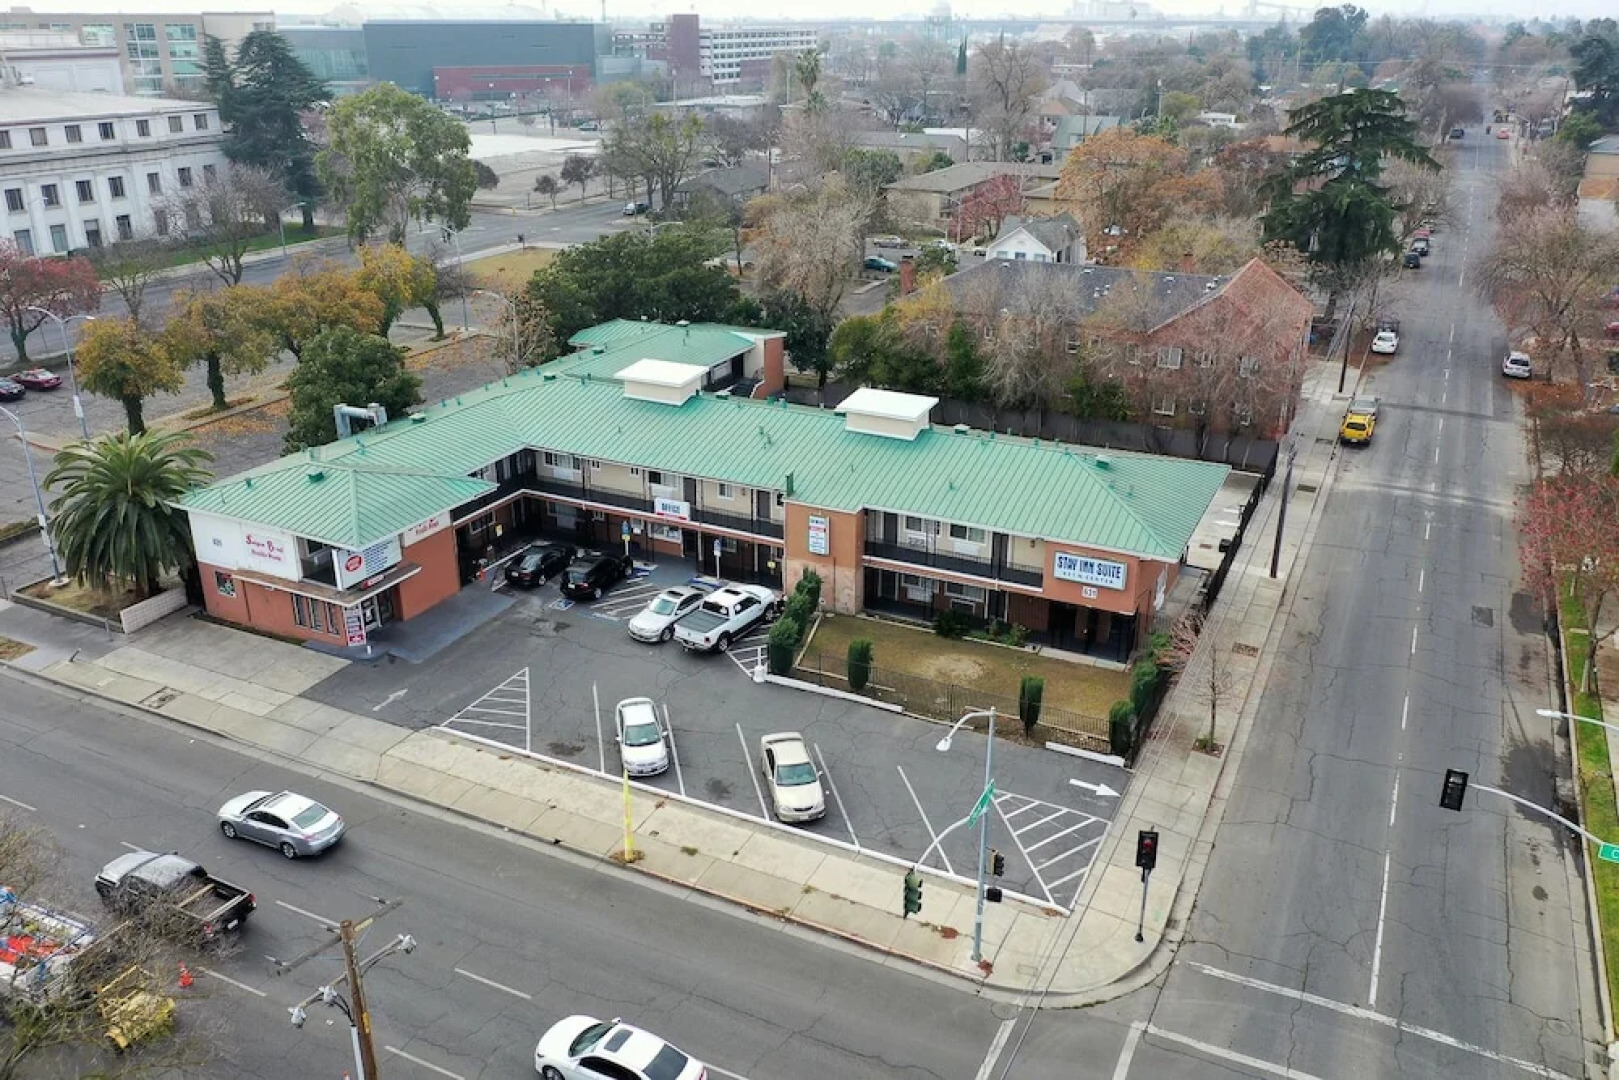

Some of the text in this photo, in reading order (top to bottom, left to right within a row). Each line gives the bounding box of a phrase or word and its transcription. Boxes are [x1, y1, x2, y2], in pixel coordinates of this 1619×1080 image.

[1057, 556, 1121, 579] STAY INN SUITE
